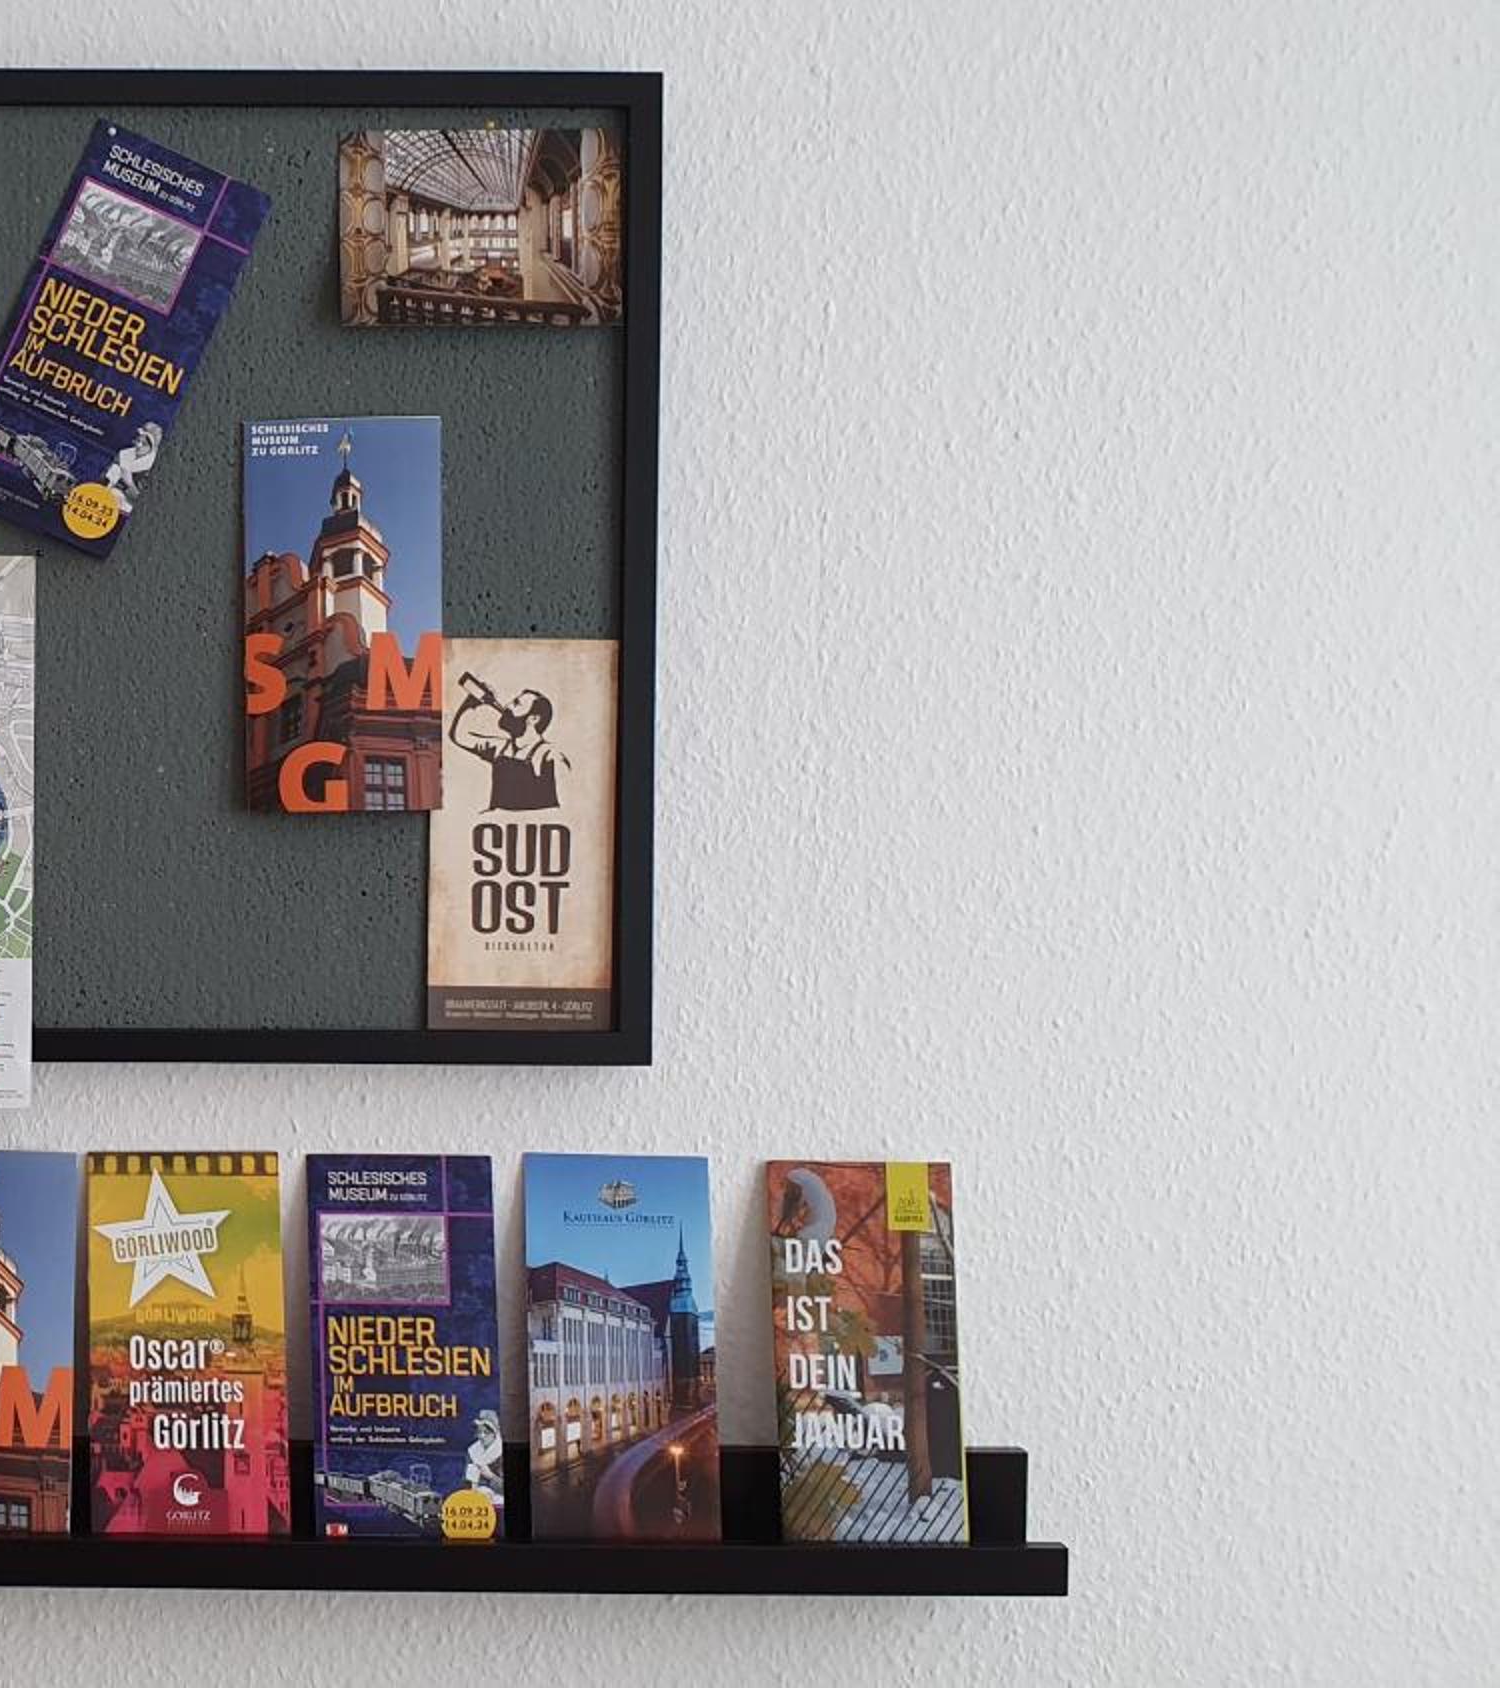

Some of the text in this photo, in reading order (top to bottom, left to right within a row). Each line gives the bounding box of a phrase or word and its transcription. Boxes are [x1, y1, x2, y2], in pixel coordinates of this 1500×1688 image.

[102, 161, 160, 194] MUSEUM
[108, 144, 205, 198] SCHLESISCHES
[39, 277, 146, 344] NIEDER
[23, 333, 47, 354] IM
[28, 305, 183, 396] SCHLESIEN
[9, 350, 132, 417] AUFBRUCH
[251, 424, 329, 434] SCHLESISCHES
[251, 435, 299, 445] MUSEUM
[251, 447, 266, 457] ZU
[245, 632, 442, 715] S M
[278, 741, 349, 812] G
[472, 823, 571, 877] SUD
[471, 880, 570, 934] OST
[328, 1171, 427, 1185] SCHLESISCHES
[329, 1187, 387, 1201] MUSEUM
[563, 1211, 623, 1224] KAUFHAUS
[785, 1239, 843, 1274] DAS
[787, 1296, 832, 1331] IST
[327, 1316, 435, 1345] NIEDER
[329, 1346, 491, 1376] SCHLESIEN
[788, 1353, 857, 1390] DEIN
[130, 1376, 244, 1407] prämiertes
[333, 1375, 354, 1393] IM
[329, 1393, 457, 1418] AUFBRUCH
[153, 1412, 245, 1449] Görlitz
[791, 1411, 906, 1450] JANUAR
[445, 1507, 489, 1517] 16.09.23
[445, 1520, 489, 1530] 14.04.24
